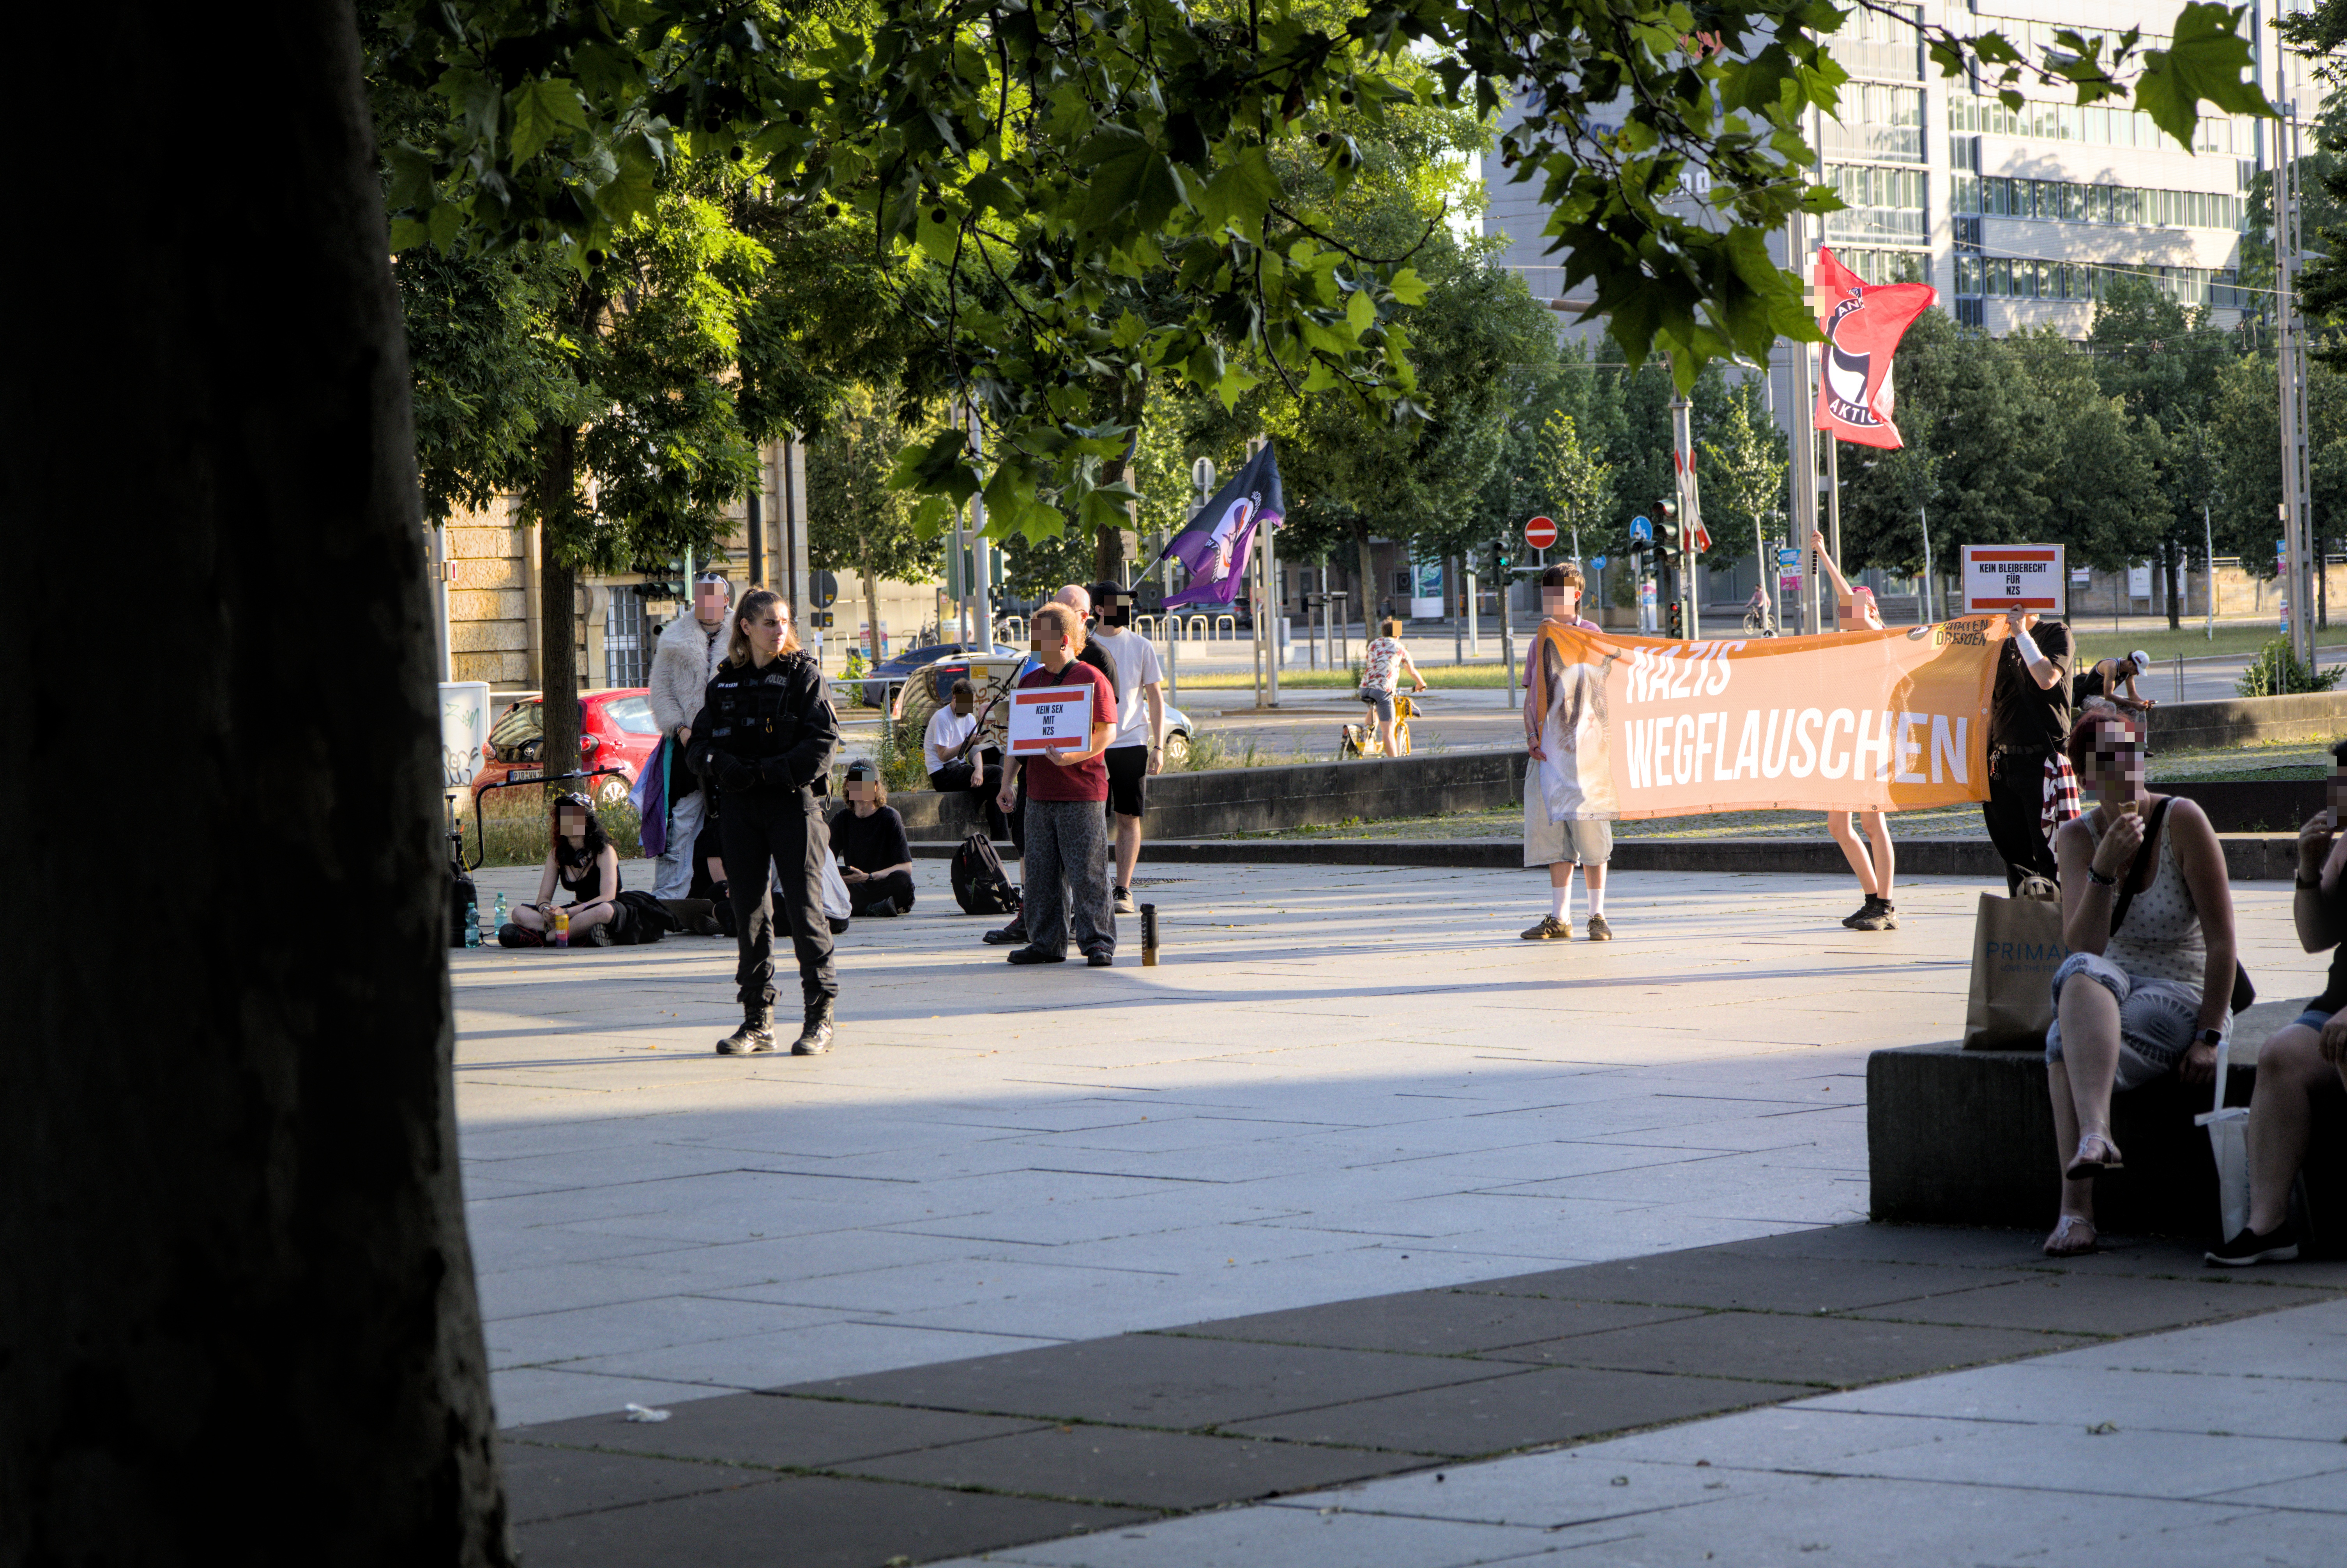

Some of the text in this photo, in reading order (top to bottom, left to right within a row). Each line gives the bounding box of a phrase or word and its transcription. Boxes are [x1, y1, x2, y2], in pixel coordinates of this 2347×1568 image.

[1838, 300, 1859, 317] AN
[1829, 398, 1877, 423] AKTIO
[1979, 563, 2047, 573] KEIN BLEIBERECHT
[2006, 573, 2020, 584] FÜR
[2006, 586, 2020, 595] NZS
[1936, 630, 1989, 646] DRESDEN
[1626, 641, 1746, 703] NAZIS
[765, 674, 787, 686] POLIZE
[1036, 704, 1063, 715] KEIN SEX
[1043, 715, 1055, 725] MIT
[1042, 726, 1054, 736] NZS
[1625, 707, 1969, 789] WEGFLAUSCHEN
[514, 772, 525, 780] PIR
